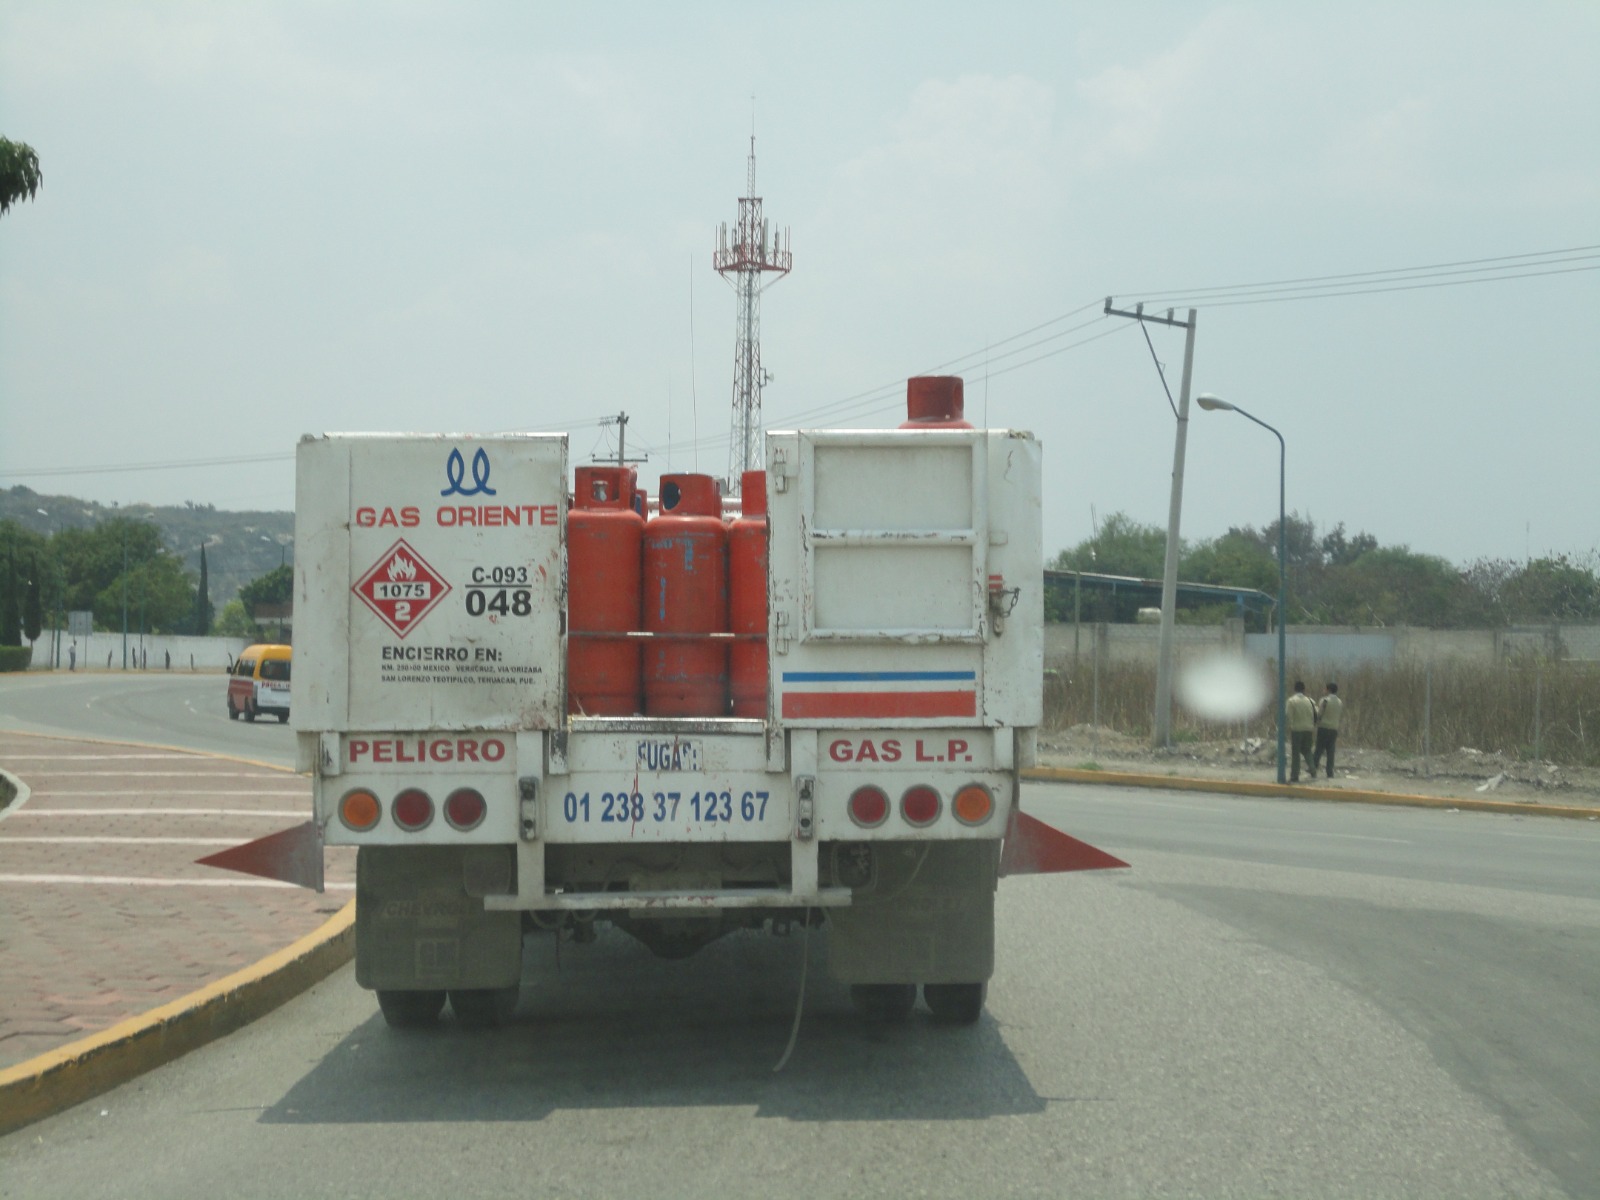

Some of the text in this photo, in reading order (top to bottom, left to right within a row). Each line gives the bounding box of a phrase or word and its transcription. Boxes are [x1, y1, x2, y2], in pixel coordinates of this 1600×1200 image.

[356, 505, 558, 528] GAS ORIENTE
[471, 566, 528, 584] C-093
[379, 584, 425, 598] 1075
[394, 601, 411, 621] 2
[465, 589, 532, 617] 048
[382, 646, 503, 662] ENCIERRO EN:
[350, 739, 506, 763] PELIGRO
[829, 739, 973, 763] GAS L.P.
[564, 791, 770, 823] 01 238 37 123 67
